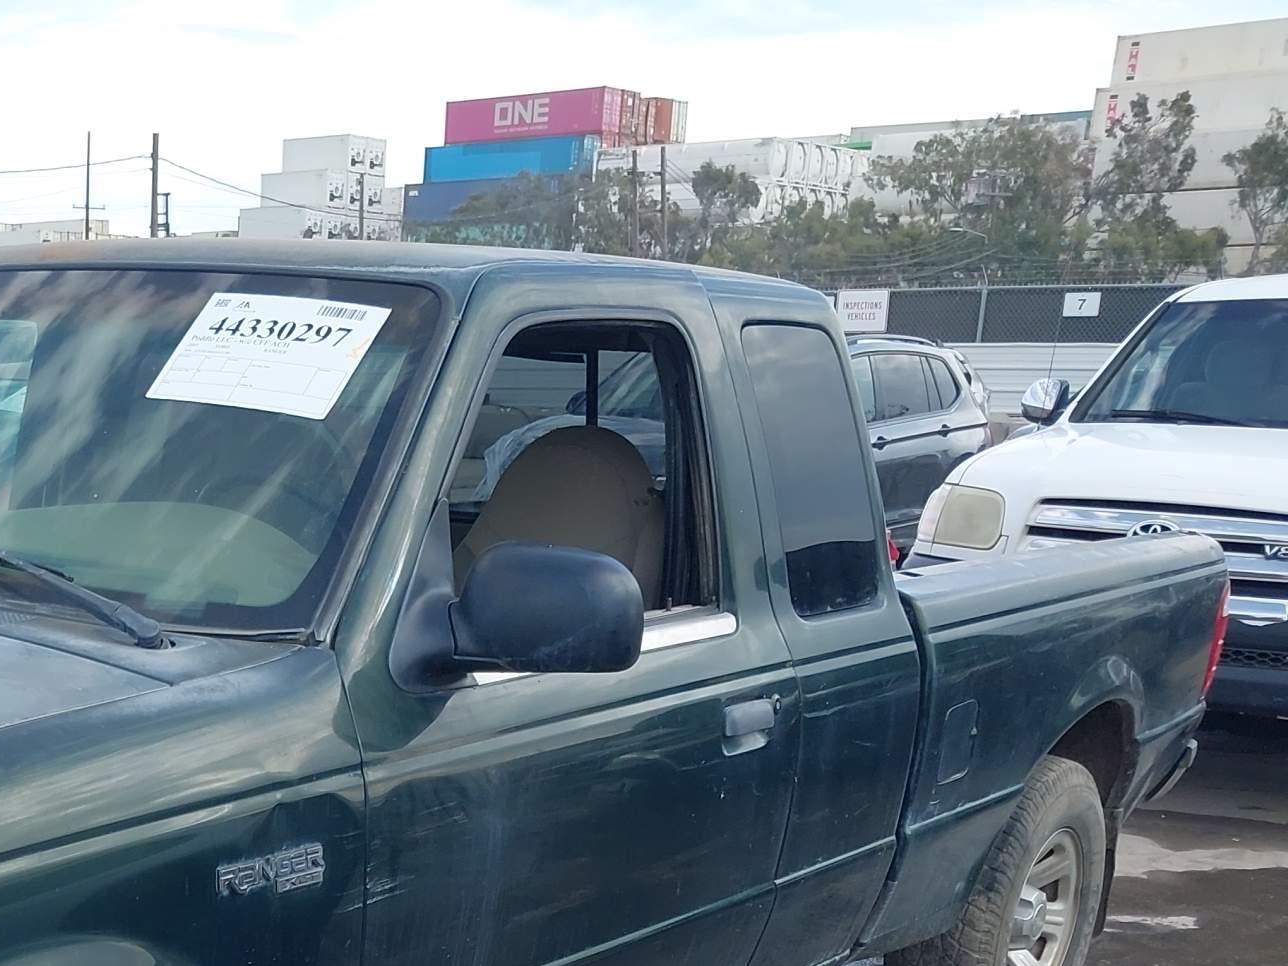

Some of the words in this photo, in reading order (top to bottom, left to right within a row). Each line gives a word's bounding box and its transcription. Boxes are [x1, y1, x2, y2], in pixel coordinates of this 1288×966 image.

[494, 98, 550, 126] ONE
[843, 301, 882, 311] INSPECTIONS
[1077, 298, 1088, 311] 7
[847, 312, 876, 320] VEHICLES
[208, 316, 354, 348] 44330297
[216, 843, 325, 895] RANGER
